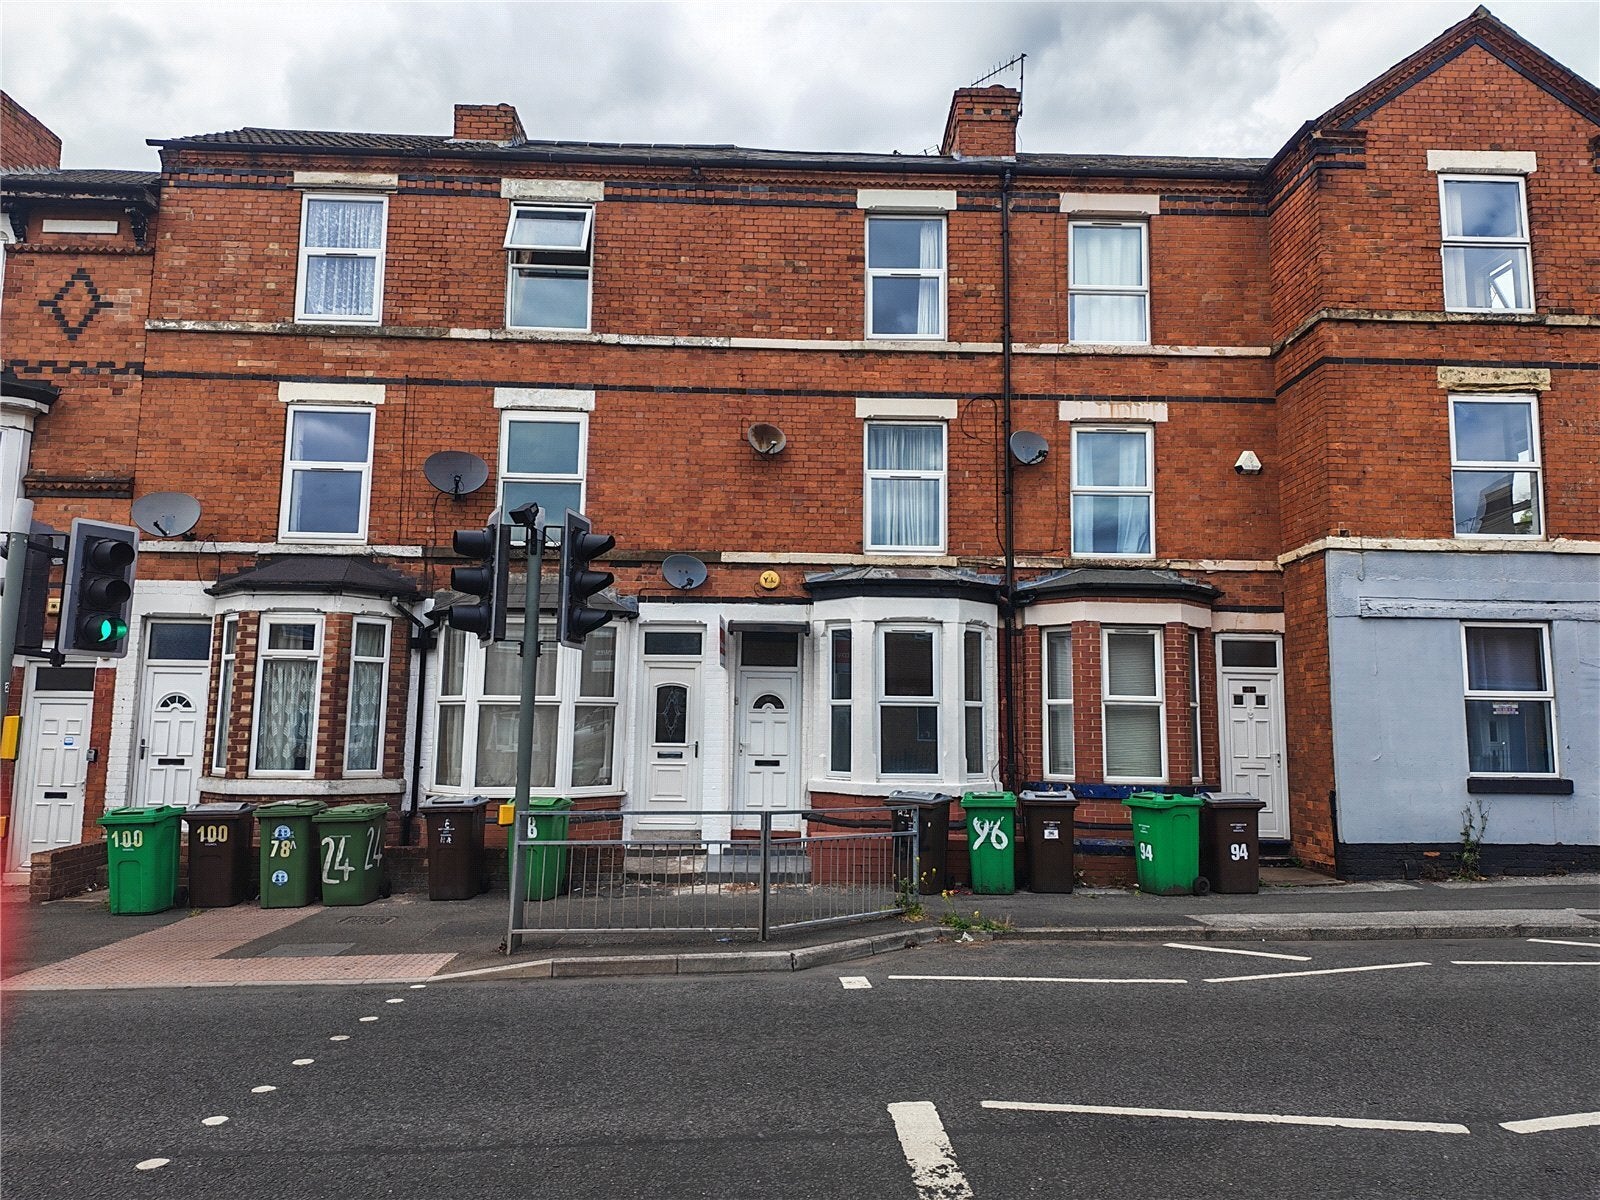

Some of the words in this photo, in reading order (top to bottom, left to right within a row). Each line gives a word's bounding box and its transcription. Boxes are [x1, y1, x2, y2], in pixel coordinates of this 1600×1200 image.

[111, 830, 143, 848] 100
[194, 825, 228, 842] 100
[321, 836, 356, 884] 24
[1140, 842, 1153, 862] 94
[1230, 843, 1249, 861] 94
